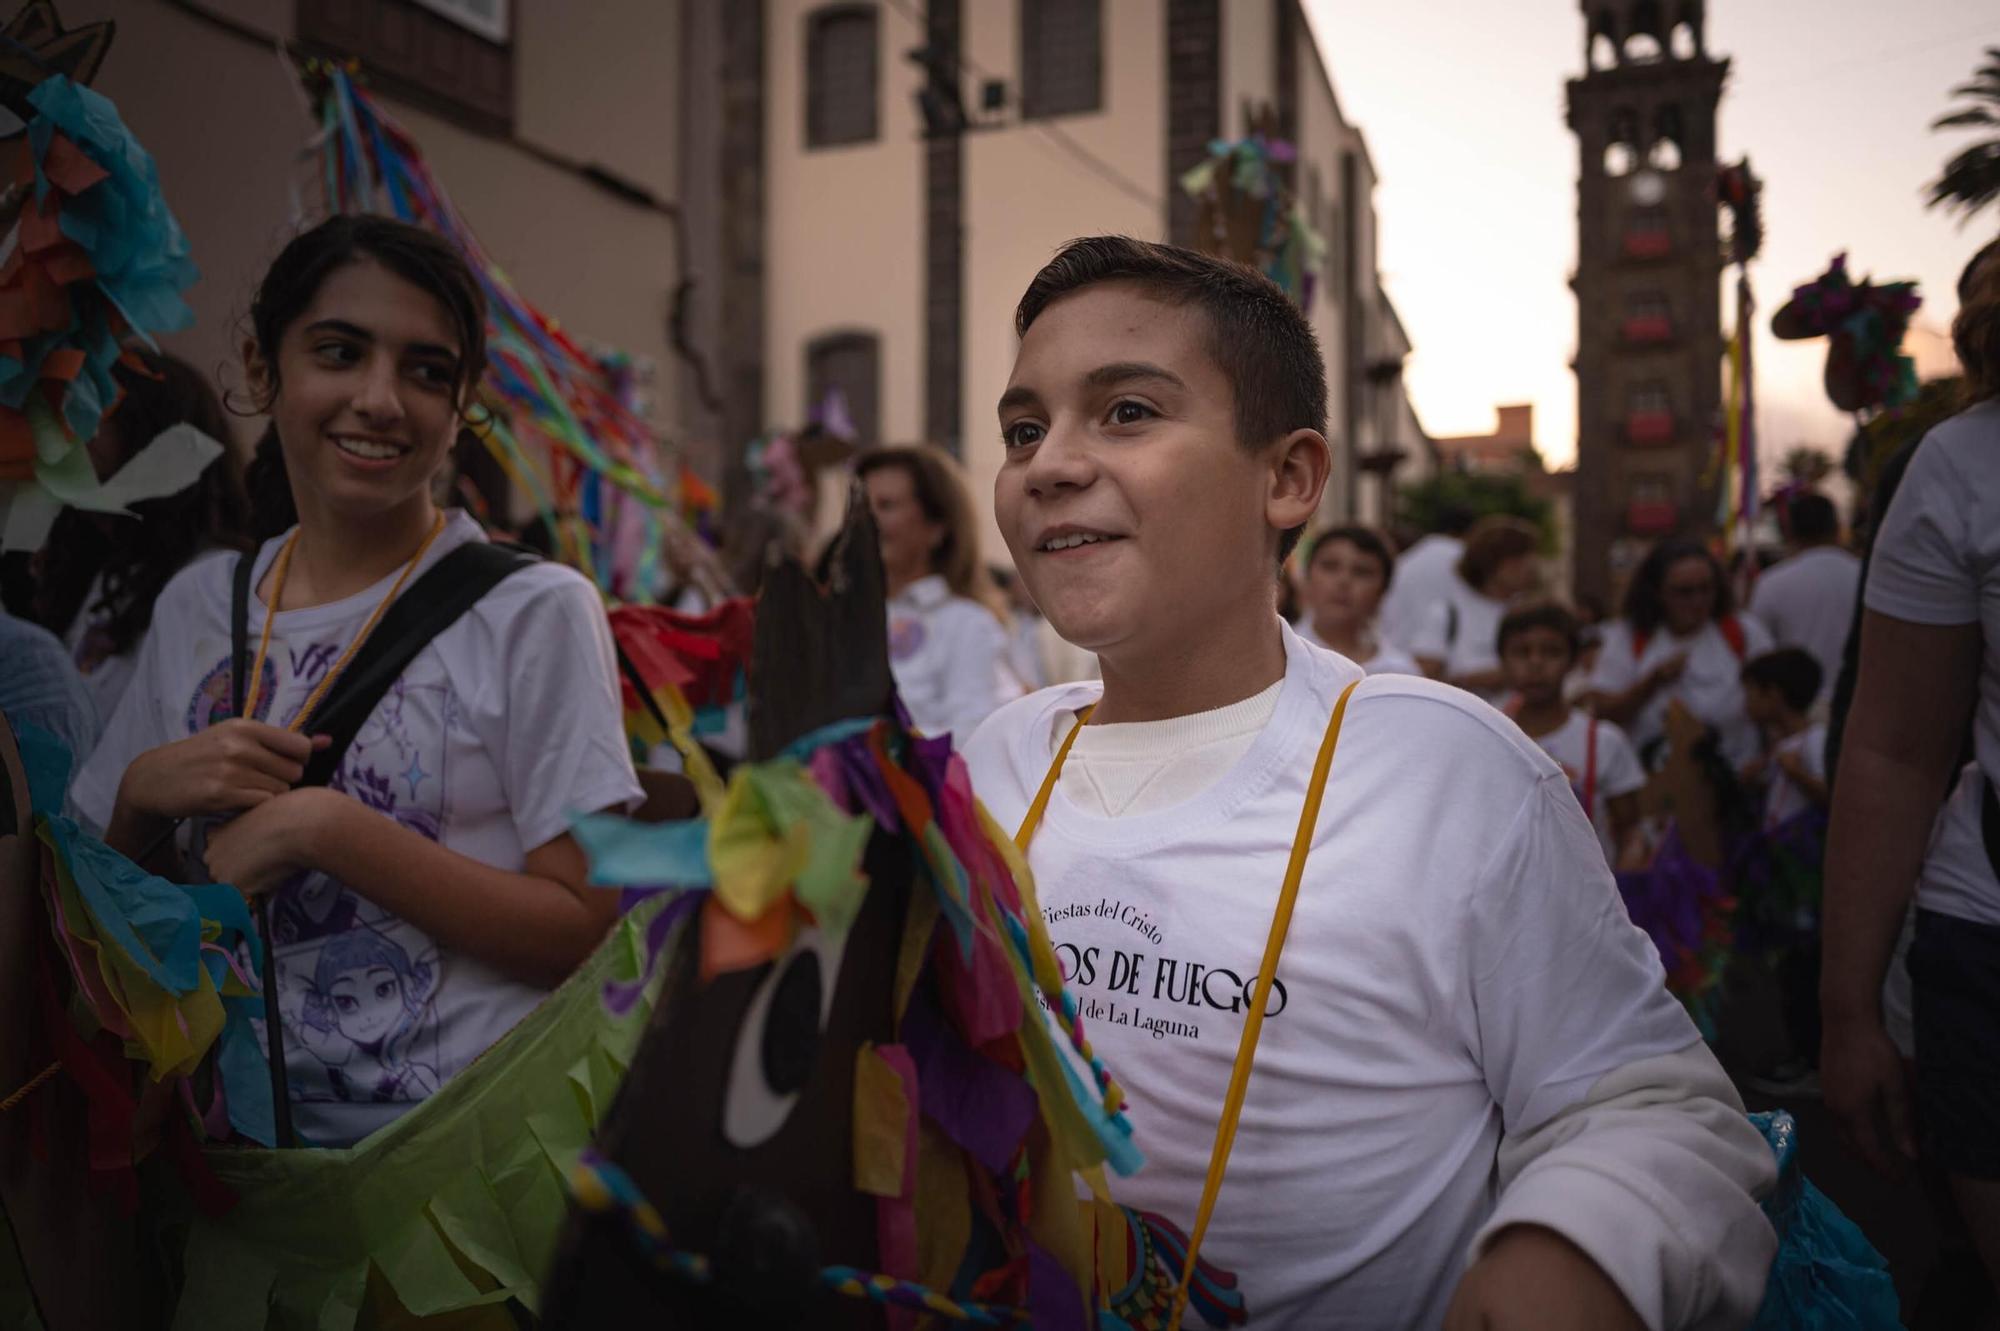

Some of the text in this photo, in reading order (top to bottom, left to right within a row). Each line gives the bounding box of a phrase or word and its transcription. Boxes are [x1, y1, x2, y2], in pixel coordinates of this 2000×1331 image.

[1094, 898, 1121, 920] del
[1121, 905, 1162, 945] Cristo
[1107, 950, 1144, 995] DE
[1153, 957, 1288, 1018] FUEGO
[1086, 998, 1104, 1019] de
[1108, 1003, 1128, 1025] La
[1133, 1007, 1199, 1040] Laguna
